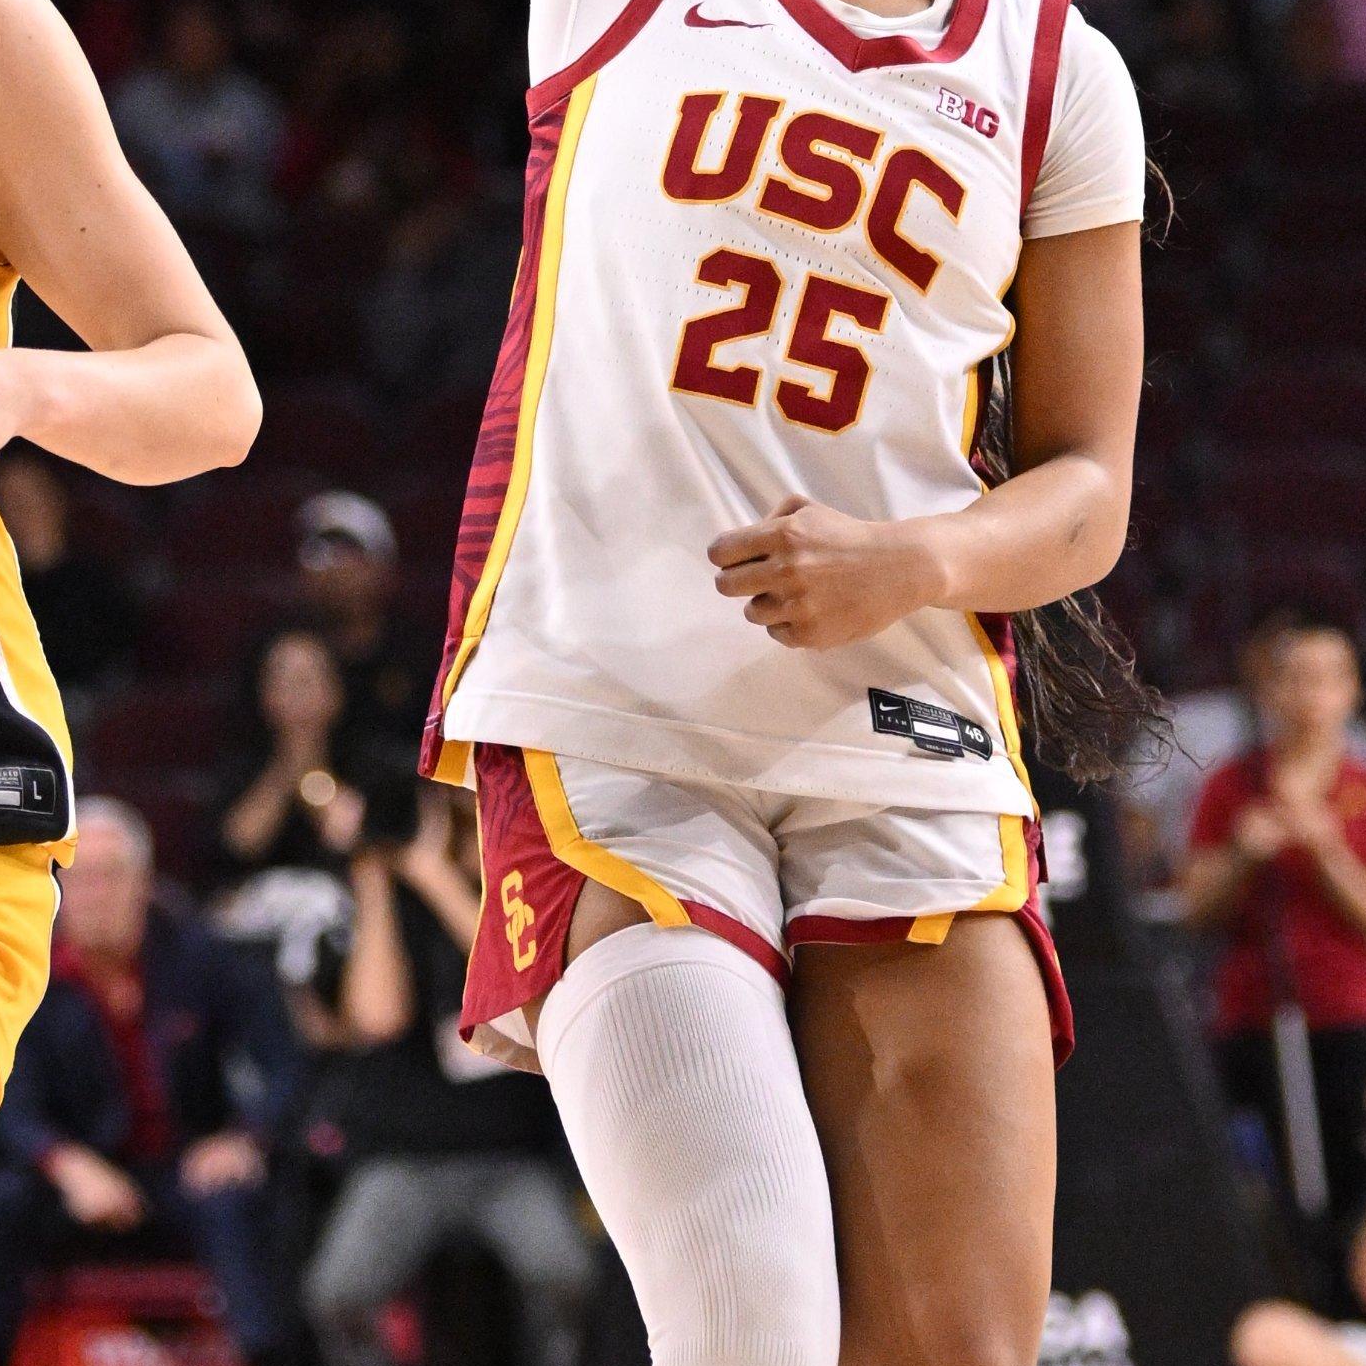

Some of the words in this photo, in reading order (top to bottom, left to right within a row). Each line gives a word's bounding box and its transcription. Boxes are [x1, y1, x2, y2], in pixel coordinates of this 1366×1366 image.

[660, 90, 967, 297] USC
[669, 246, 893, 436] 25
[33, 780, 42, 800] L
